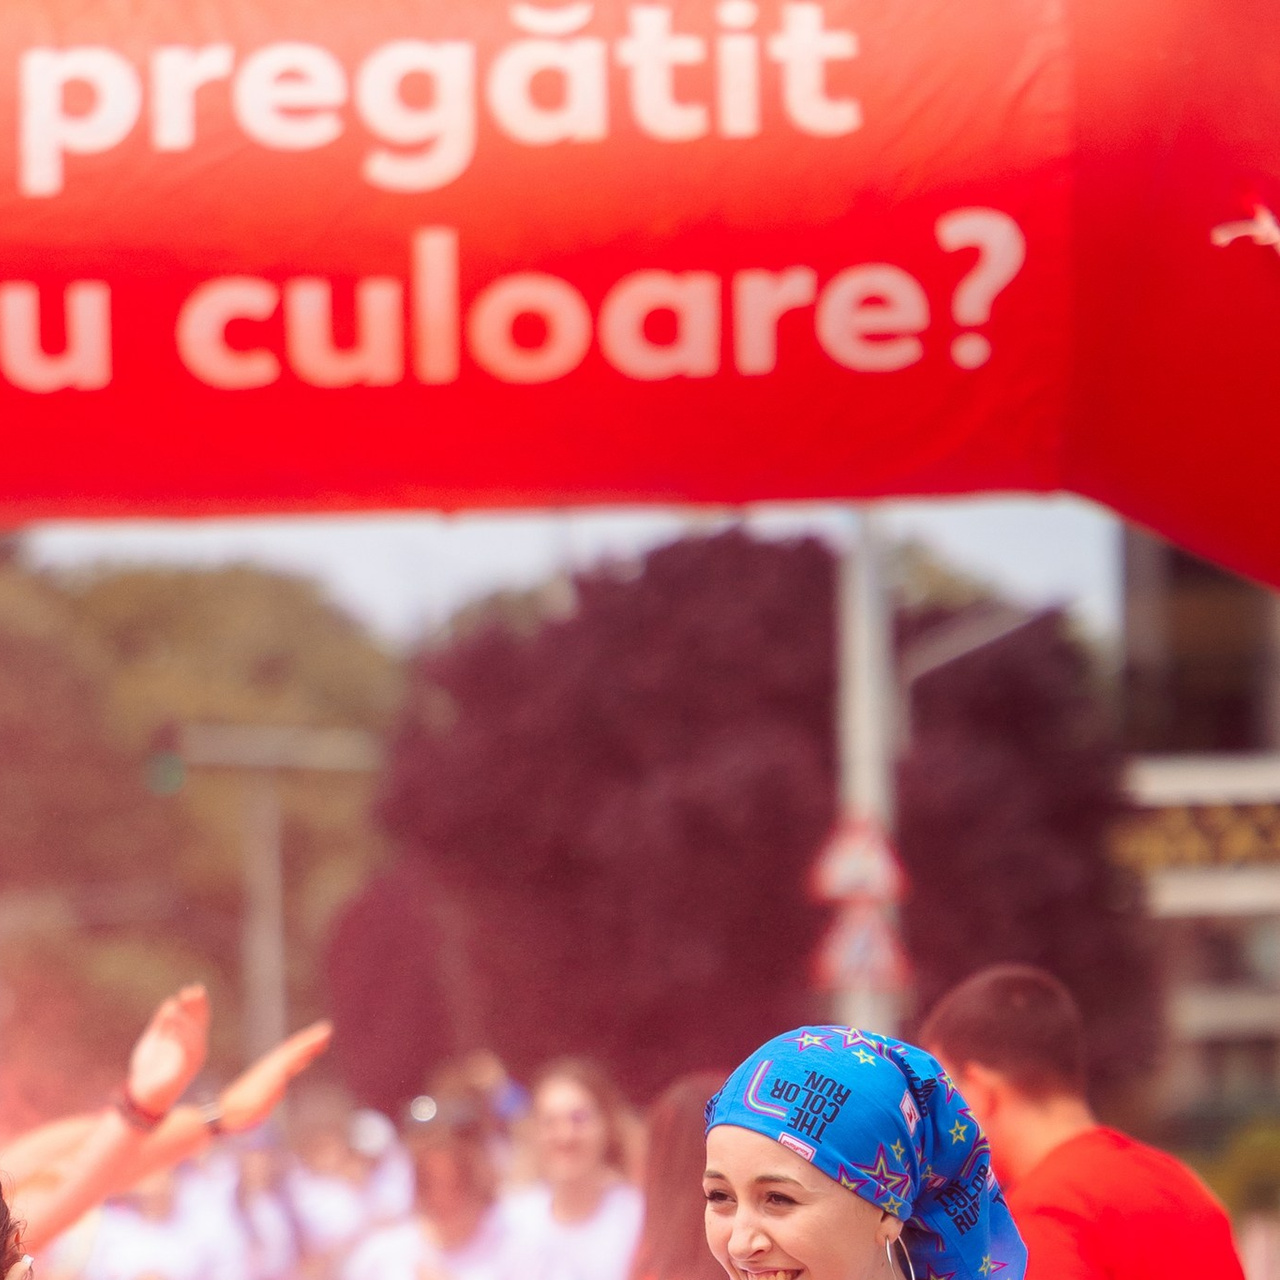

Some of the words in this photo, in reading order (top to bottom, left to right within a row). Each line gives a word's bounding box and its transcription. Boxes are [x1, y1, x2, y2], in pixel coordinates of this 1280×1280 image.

[18, 0, 864, 196] pregătit
[175, 210, 1027, 389] culoare?
[770, 1078, 840, 1124] COLOR
[787, 1107, 828, 1145] THE
